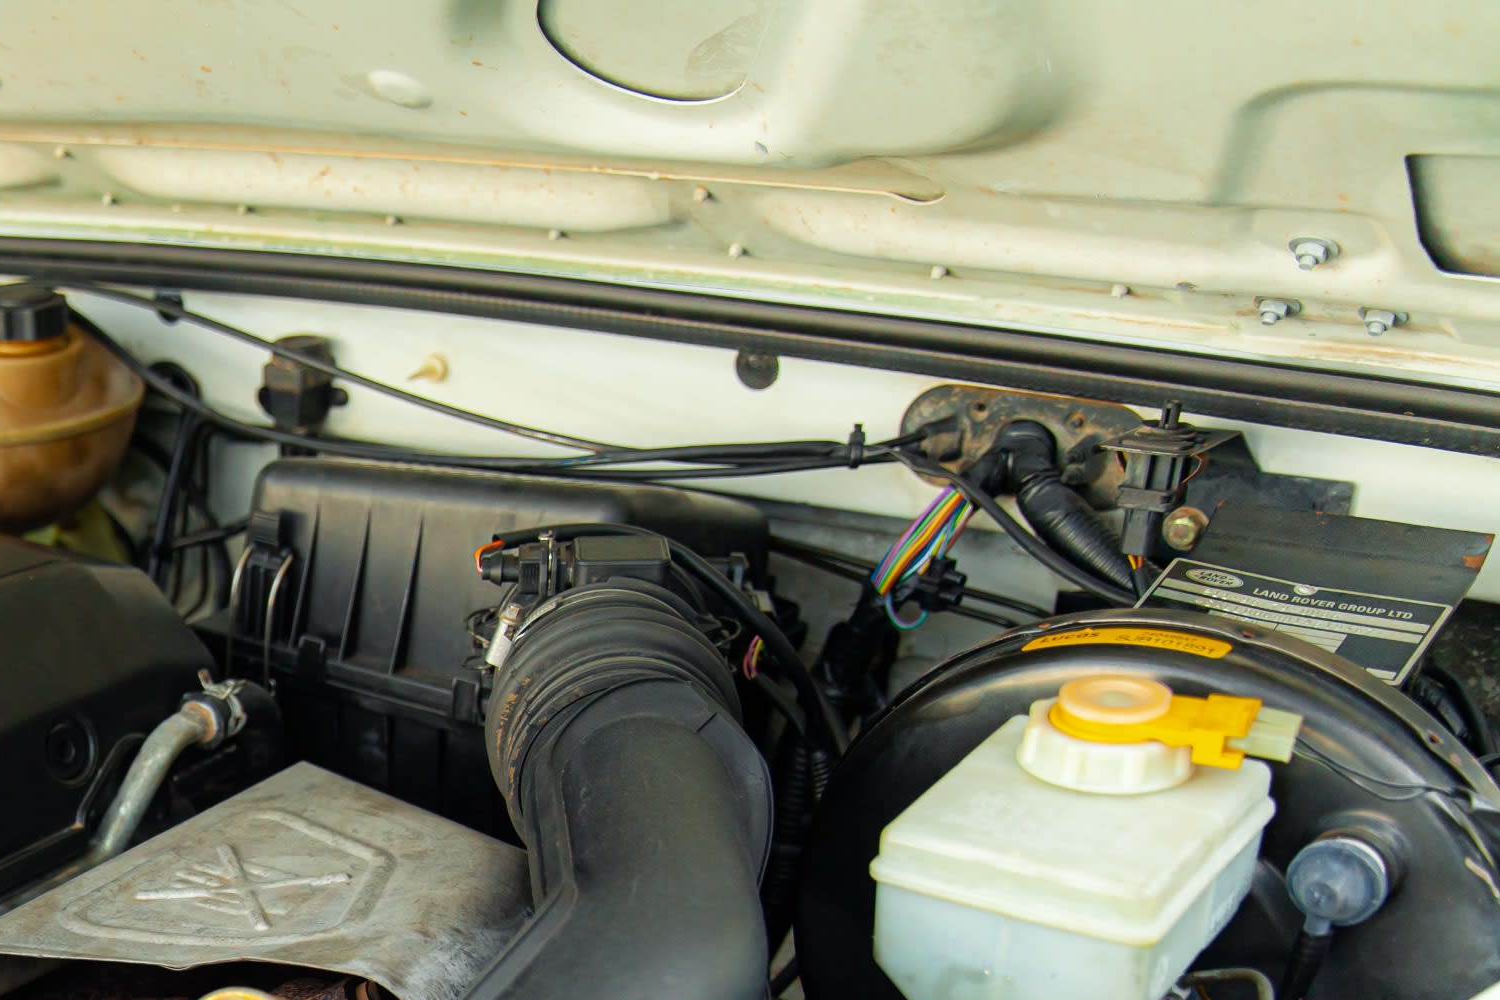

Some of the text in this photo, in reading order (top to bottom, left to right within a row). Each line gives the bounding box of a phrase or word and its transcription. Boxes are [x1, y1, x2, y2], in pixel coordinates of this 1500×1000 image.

[1200, 569, 1227, 580] LAND
[1201, 575, 1233, 586] ROVER
[1253, 587, 1289, 601] LAND
[1291, 595, 1336, 609] ROVER
[1338, 602, 1386, 616] GROUP
[1388, 608, 1413, 620] LTD
